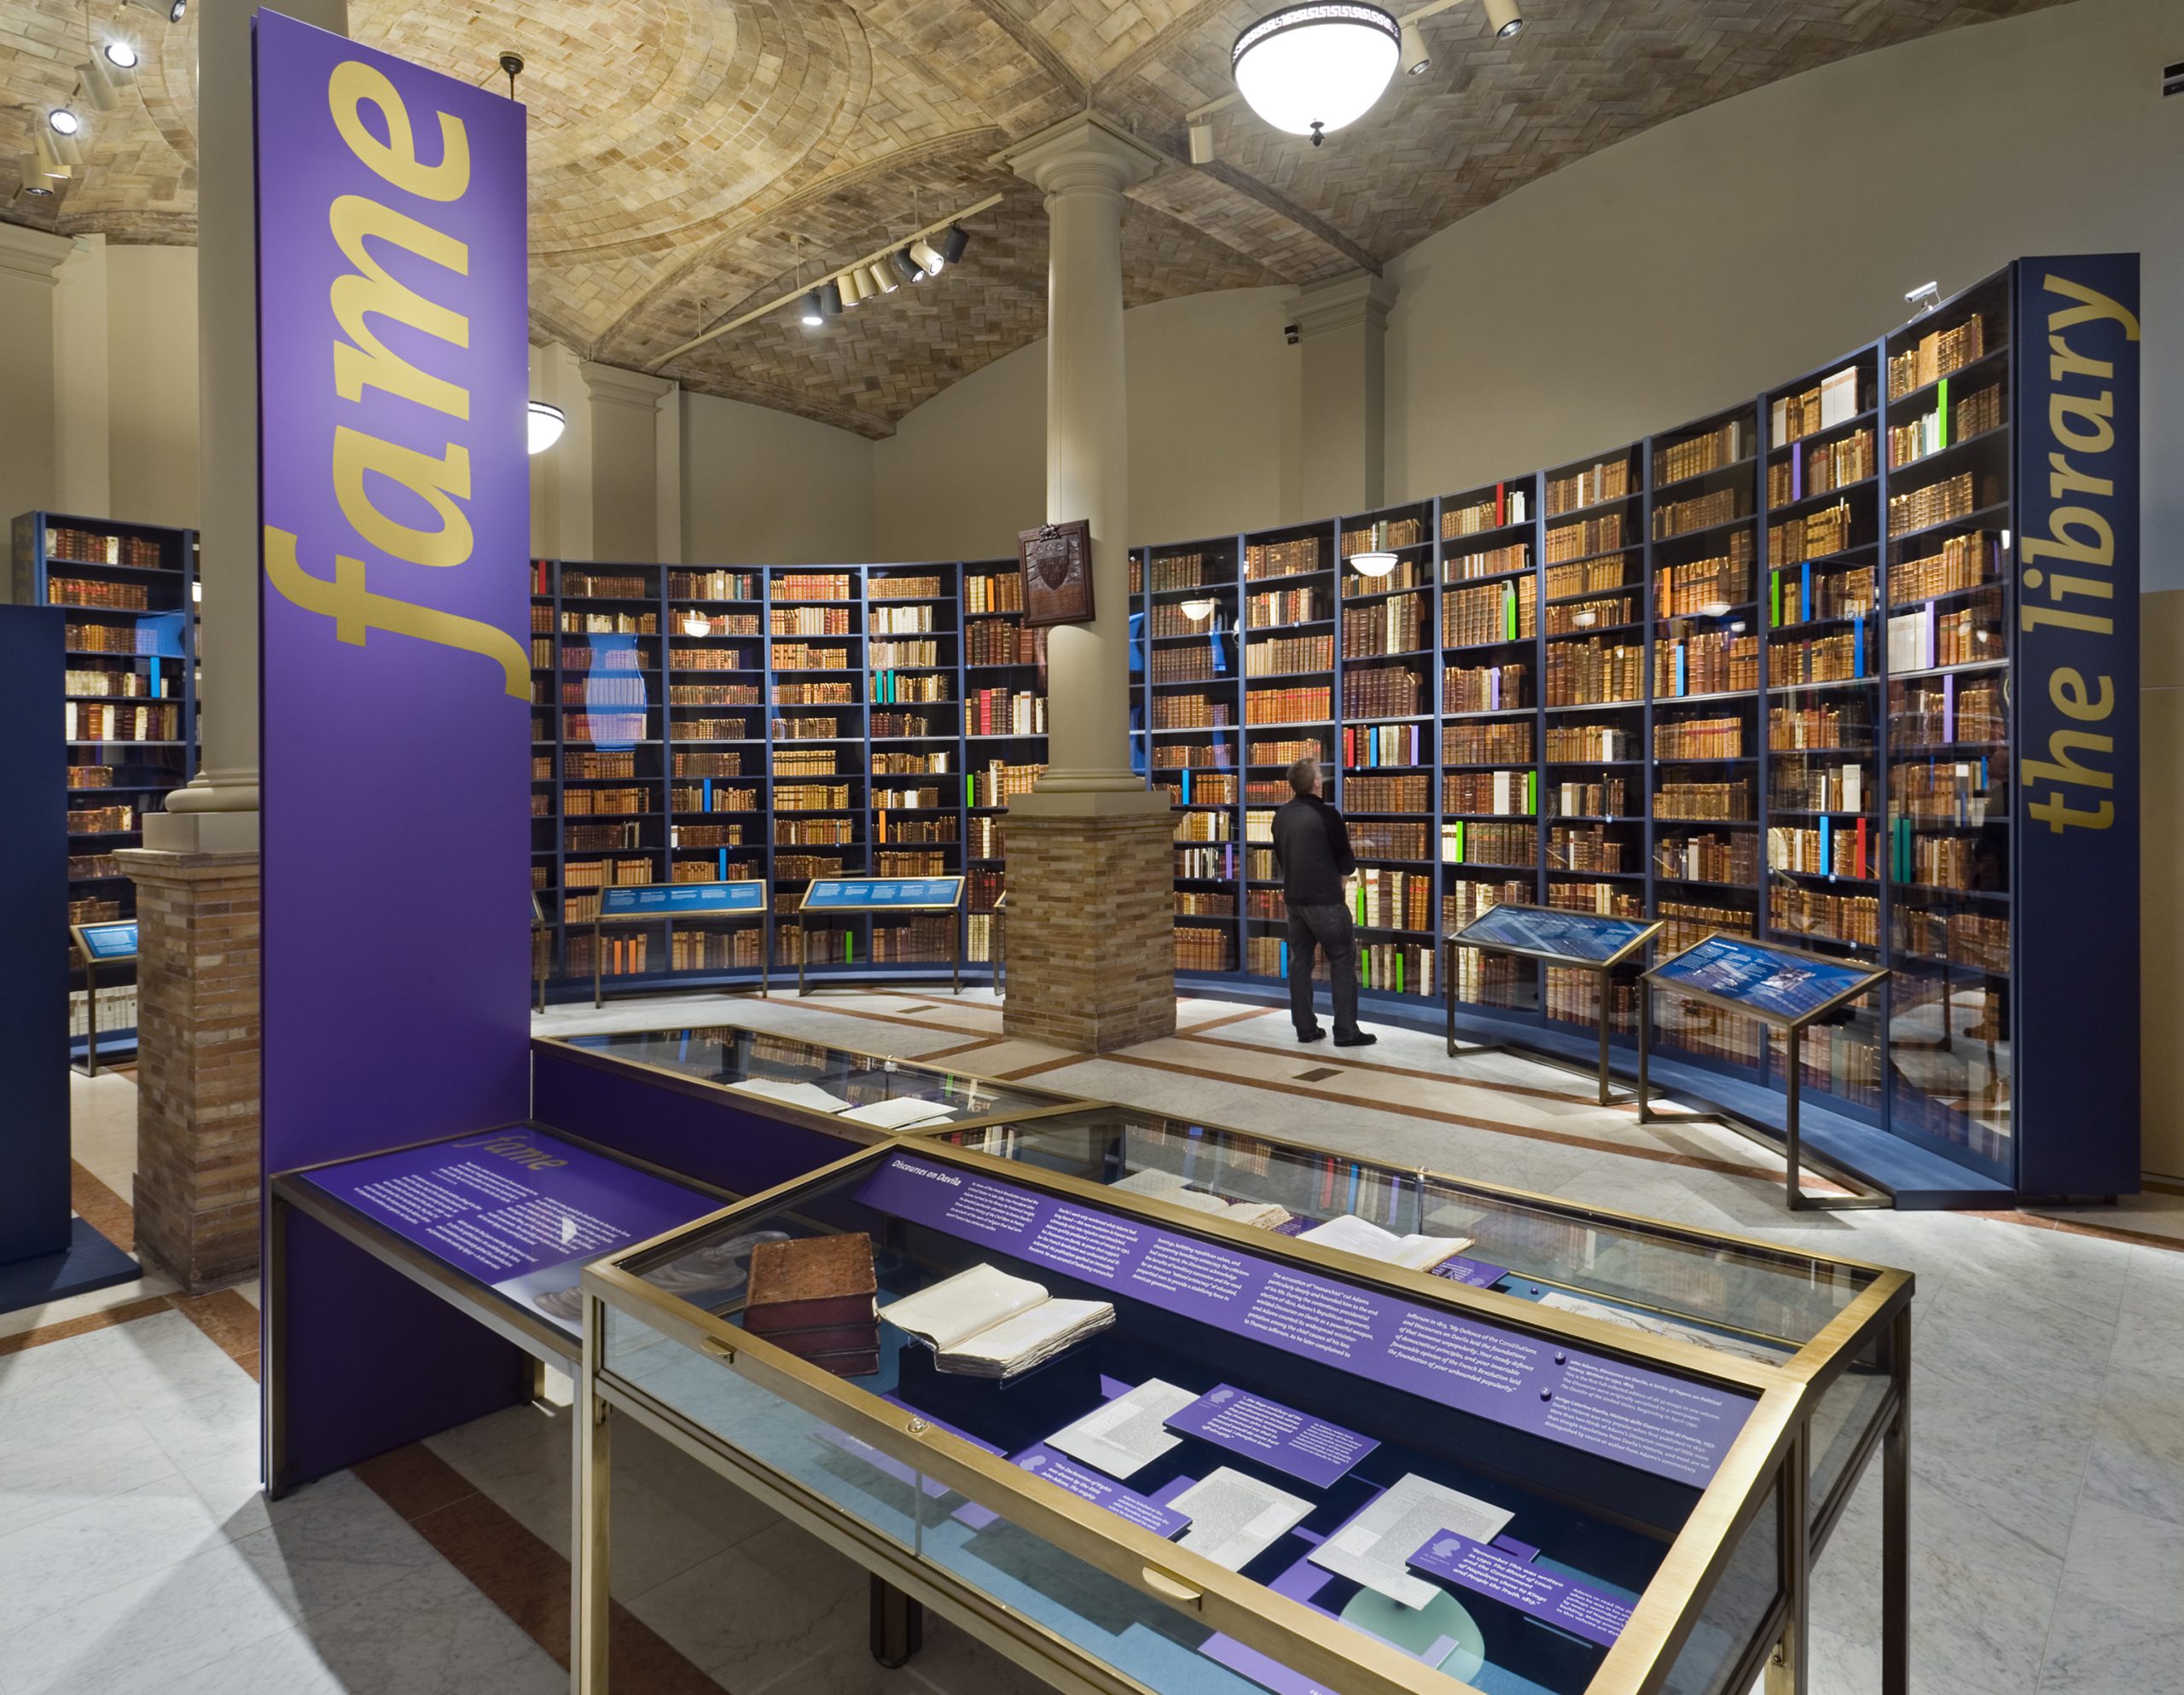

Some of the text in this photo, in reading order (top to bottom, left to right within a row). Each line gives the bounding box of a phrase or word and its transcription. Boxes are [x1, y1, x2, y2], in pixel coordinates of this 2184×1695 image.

[264, 61, 531, 702] fame
[2021, 274, 2140, 833] the library
[451, 1135, 568, 1170] fame
[892, 1160, 927, 1175] Discourses
[936, 1173, 961, 1186] Davila
[1268, 1280, 1295, 1291] particularly
[1294, 1286, 1310, 1296] deeply
[1321, 1294, 1342, 1305] hounded
[1281, 1276, 1306, 1286] accusation
[1351, 1297, 1369, 1305] Adams
[1286, 1292, 1303, 1302] During
[1311, 1300, 1339, 1312] contentious
[1339, 1309, 1369, 1321] presidential
[1247, 1312, 1270, 1322] pretation
[1270, 1320, 1287, 1329] among
[1309, 1332, 1326, 1341] causes
[1257, 1299, 1275, 1308] wielded
[1274, 1304, 1298, 1315] Discourses
[1304, 1314, 1320, 1322] Davila
[1329, 1322, 1353, 1332] powerful
[1260, 1292, 1279, 1301] election
[1295, 1303, 1316, 1313] Adams's
[1316, 1309, 1343, 1321] Republican
[1343, 1319, 1370, 1330] opponents
[1261, 1309, 1278, 1317] Adams
[1278, 1315, 1298, 1323] counted
[1305, 1323, 1334, 1335] widespread
[1250, 1320, 1268, 1330] Thomas
[1315, 1343, 1345, 1355] complained
[1406, 1313, 1430, 1322] Jefferson
[1459, 1327, 1481, 1338] Defence
[1499, 1339, 1536, 1355] Constitutions
[1414, 1323, 1442, 1335] Discourses
[1451, 1334, 1469, 1343] Davila
[1490, 1346, 1526, 1360] foundations
[1390, 1341, 1420, 1354] favourable
[1420, 1351, 1441, 1360] opinion
[1458, 1362, 1478, 1372] French
[1478, 1368, 1508, 1381] Revolution
[1508, 1377, 1522, 1385] laid
[1396, 1351, 1427, 1365] foundation
[1448, 1368, 1482, 1382] unbounded
[1402, 1336, 1437, 1350] democratical
[1490, 1363, 1520, 1376] invariable
[1417, 1332, 1441, 1343] immense
[1492, 1355, 1512, 1365] steady
[1511, 1361, 1534, 1371] defence
[1467, 1566, 1499, 1582] Napoleon
[1499, 1580, 1519, 1589] show
[1472, 1547, 1508, 1564] "Remember
[1537, 1575, 1563, 1587] written
[1490, 1569, 1533, 1588] Government
[1506, 1569, 1526, 1578] Blood
[1467, 1574, 1489, 1585] People
[1502, 1588, 1519, 1599] Truth.
